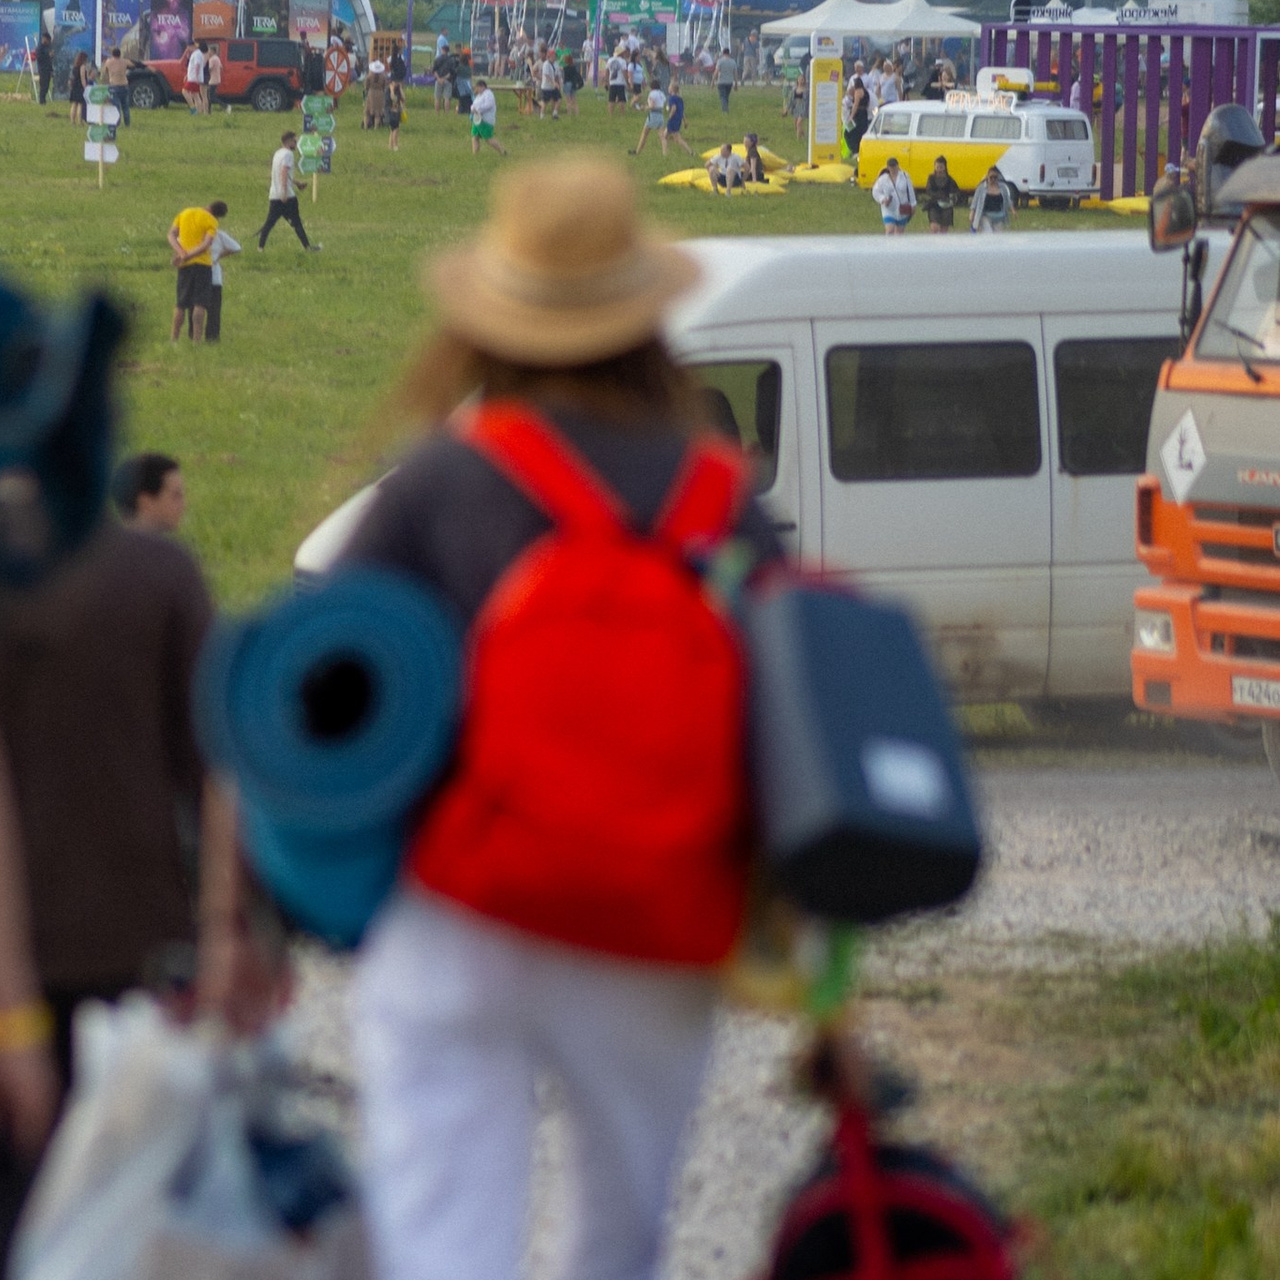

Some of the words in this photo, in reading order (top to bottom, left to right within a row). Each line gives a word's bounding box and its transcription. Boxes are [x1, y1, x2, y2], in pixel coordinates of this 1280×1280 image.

[62, 11, 85, 22] TERRA
[108, 12, 132, 23] TERRA
[157, 14, 181, 25] TERRA
[201, 14, 224, 25] TERRA
[253, 16, 277, 28] TERRA
[296, 16, 320, 28] TERRA
